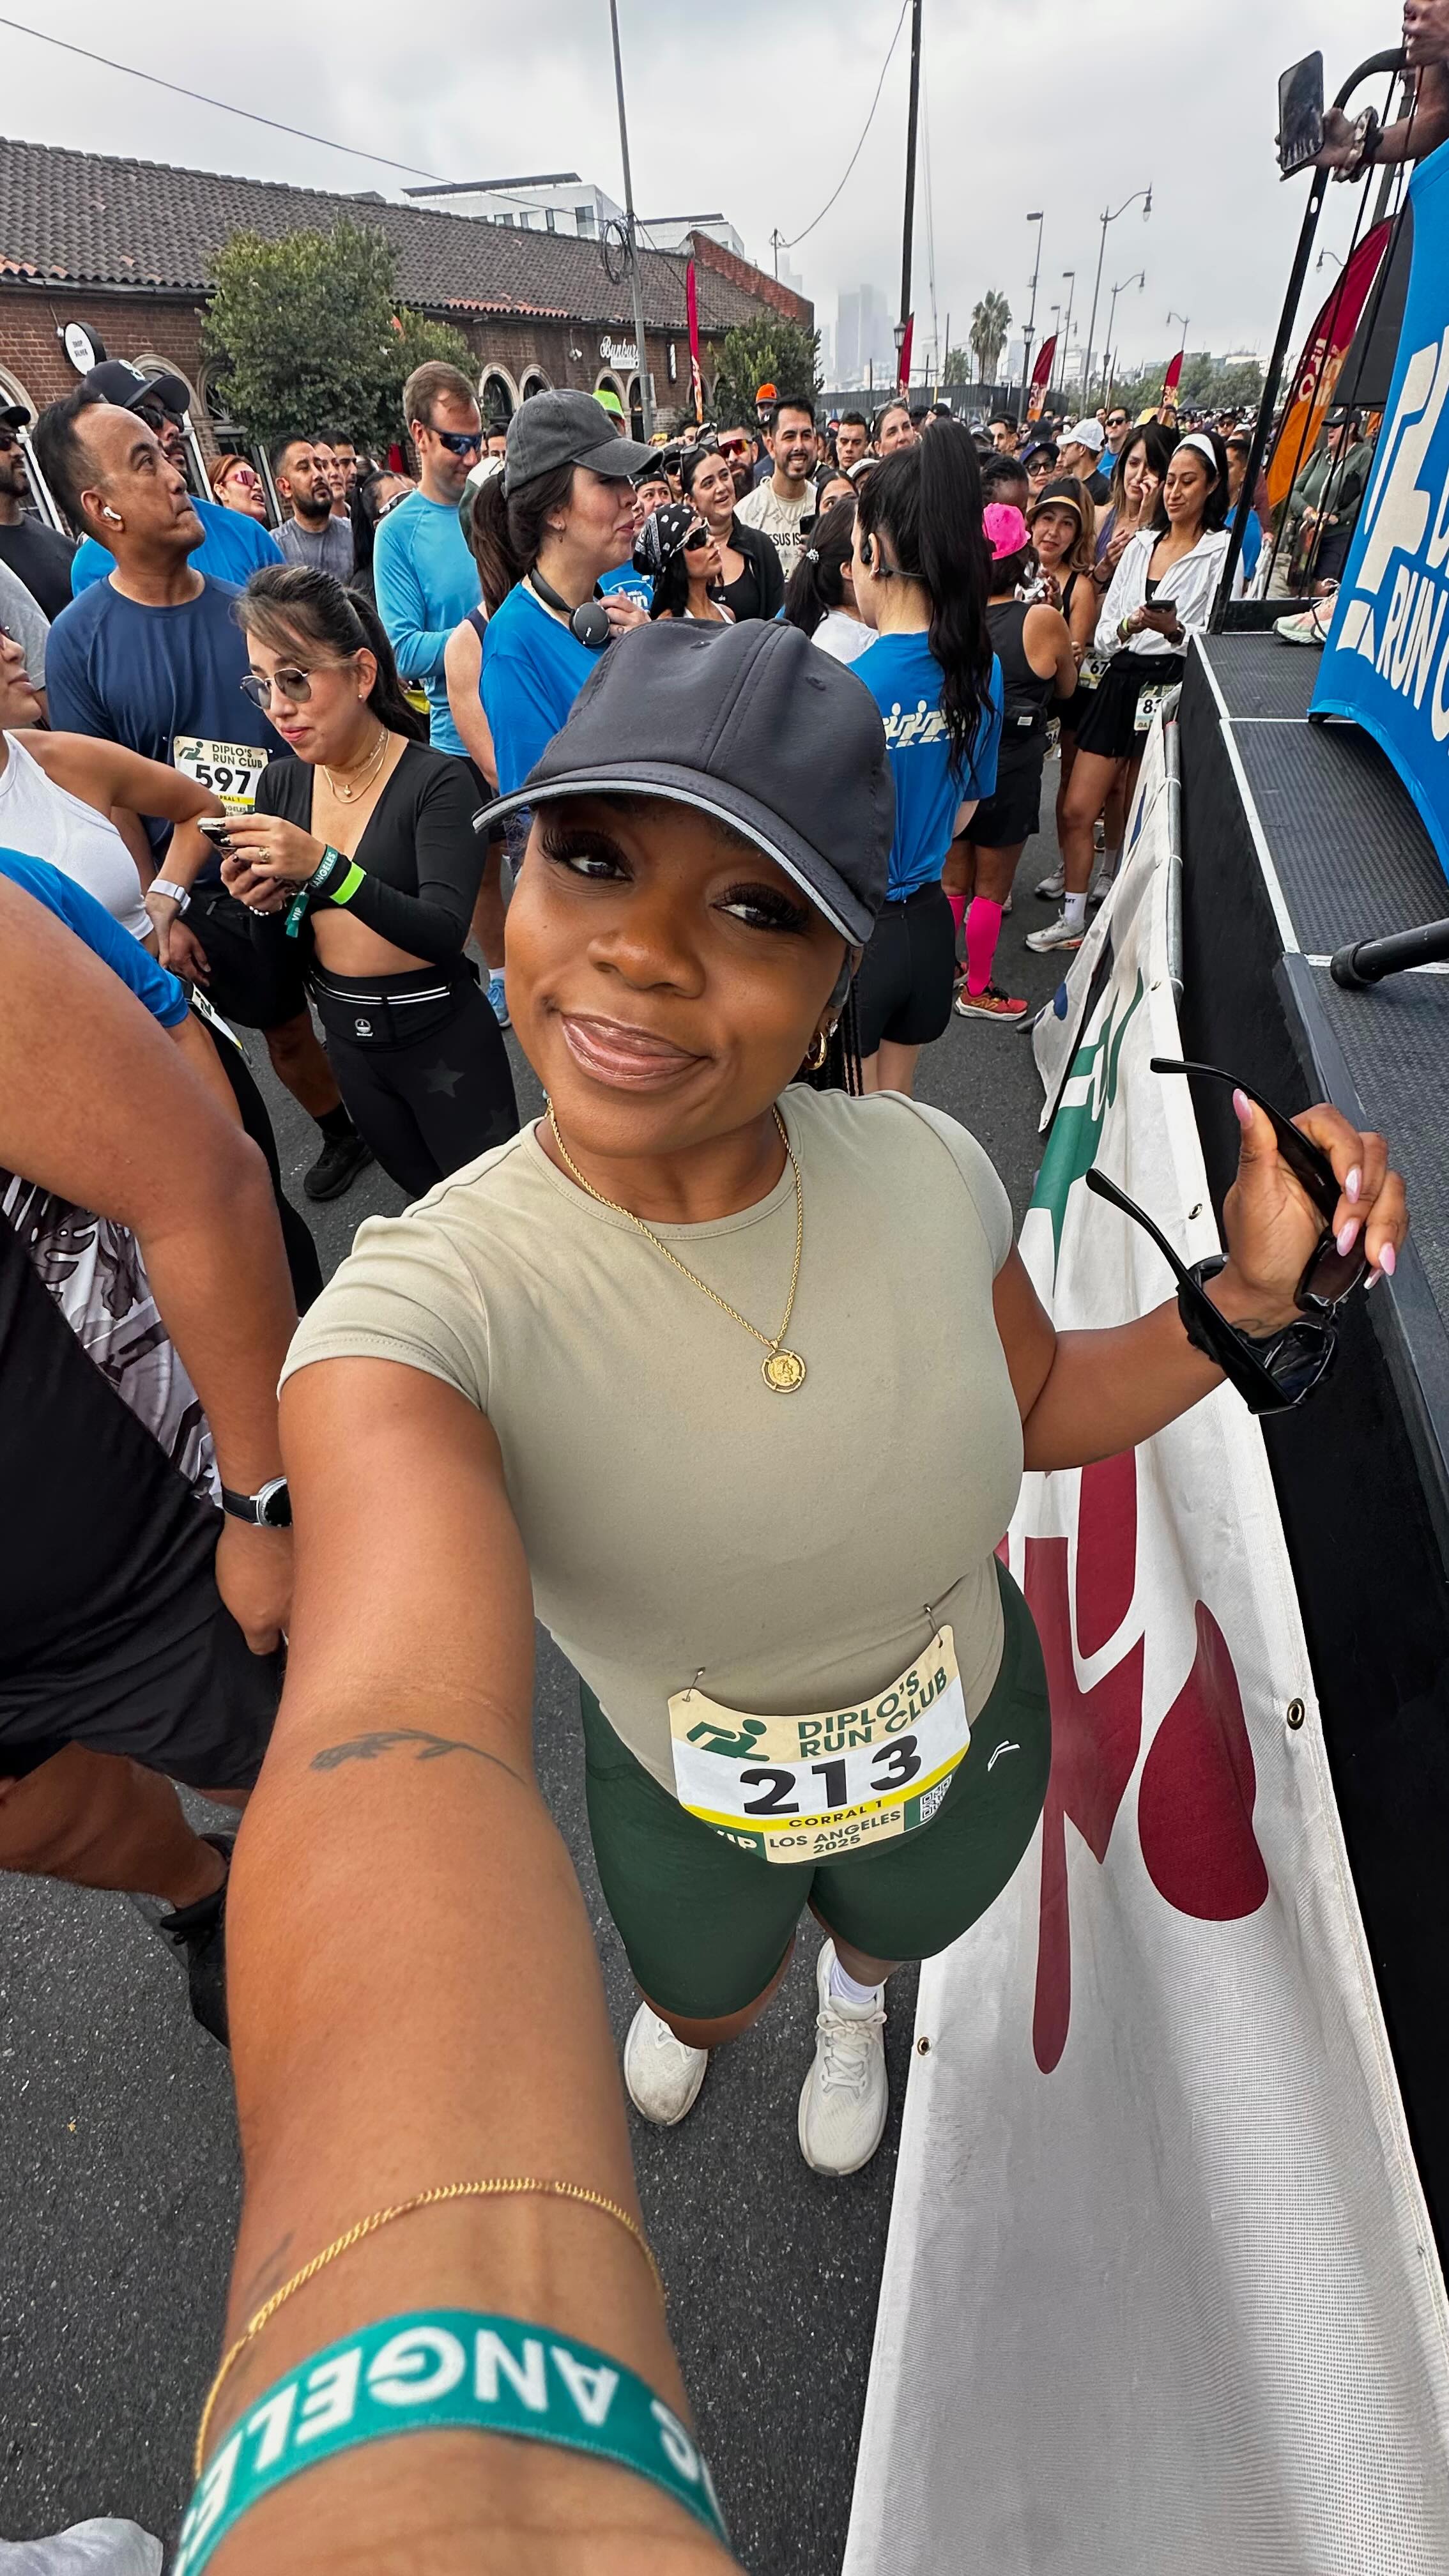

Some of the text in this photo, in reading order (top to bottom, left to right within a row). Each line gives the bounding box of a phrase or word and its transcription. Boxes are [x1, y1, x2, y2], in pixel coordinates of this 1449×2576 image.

[768, 533, 790, 546] SUS
[1376, 564, 1448, 711] RUN
[212, 744, 253, 758] DIPLO'S
[213, 754, 263, 769] RUN CLUB
[195, 763, 251, 794] 597
[313, 851, 336, 887] ANGELES
[291, 907, 302, 921] VIP
[797, 1669, 920, 1740] DIPLO'S
[800, 1666, 947, 1758] RUN CLUB
[739, 1735, 922, 1816] 213
[789, 1800, 882, 1827] CORRAL 1
[716, 1830, 757, 1849] IP
[769, 1810, 901, 1848] LOS ANGELES
[813, 1834, 861, 1854] 2025
